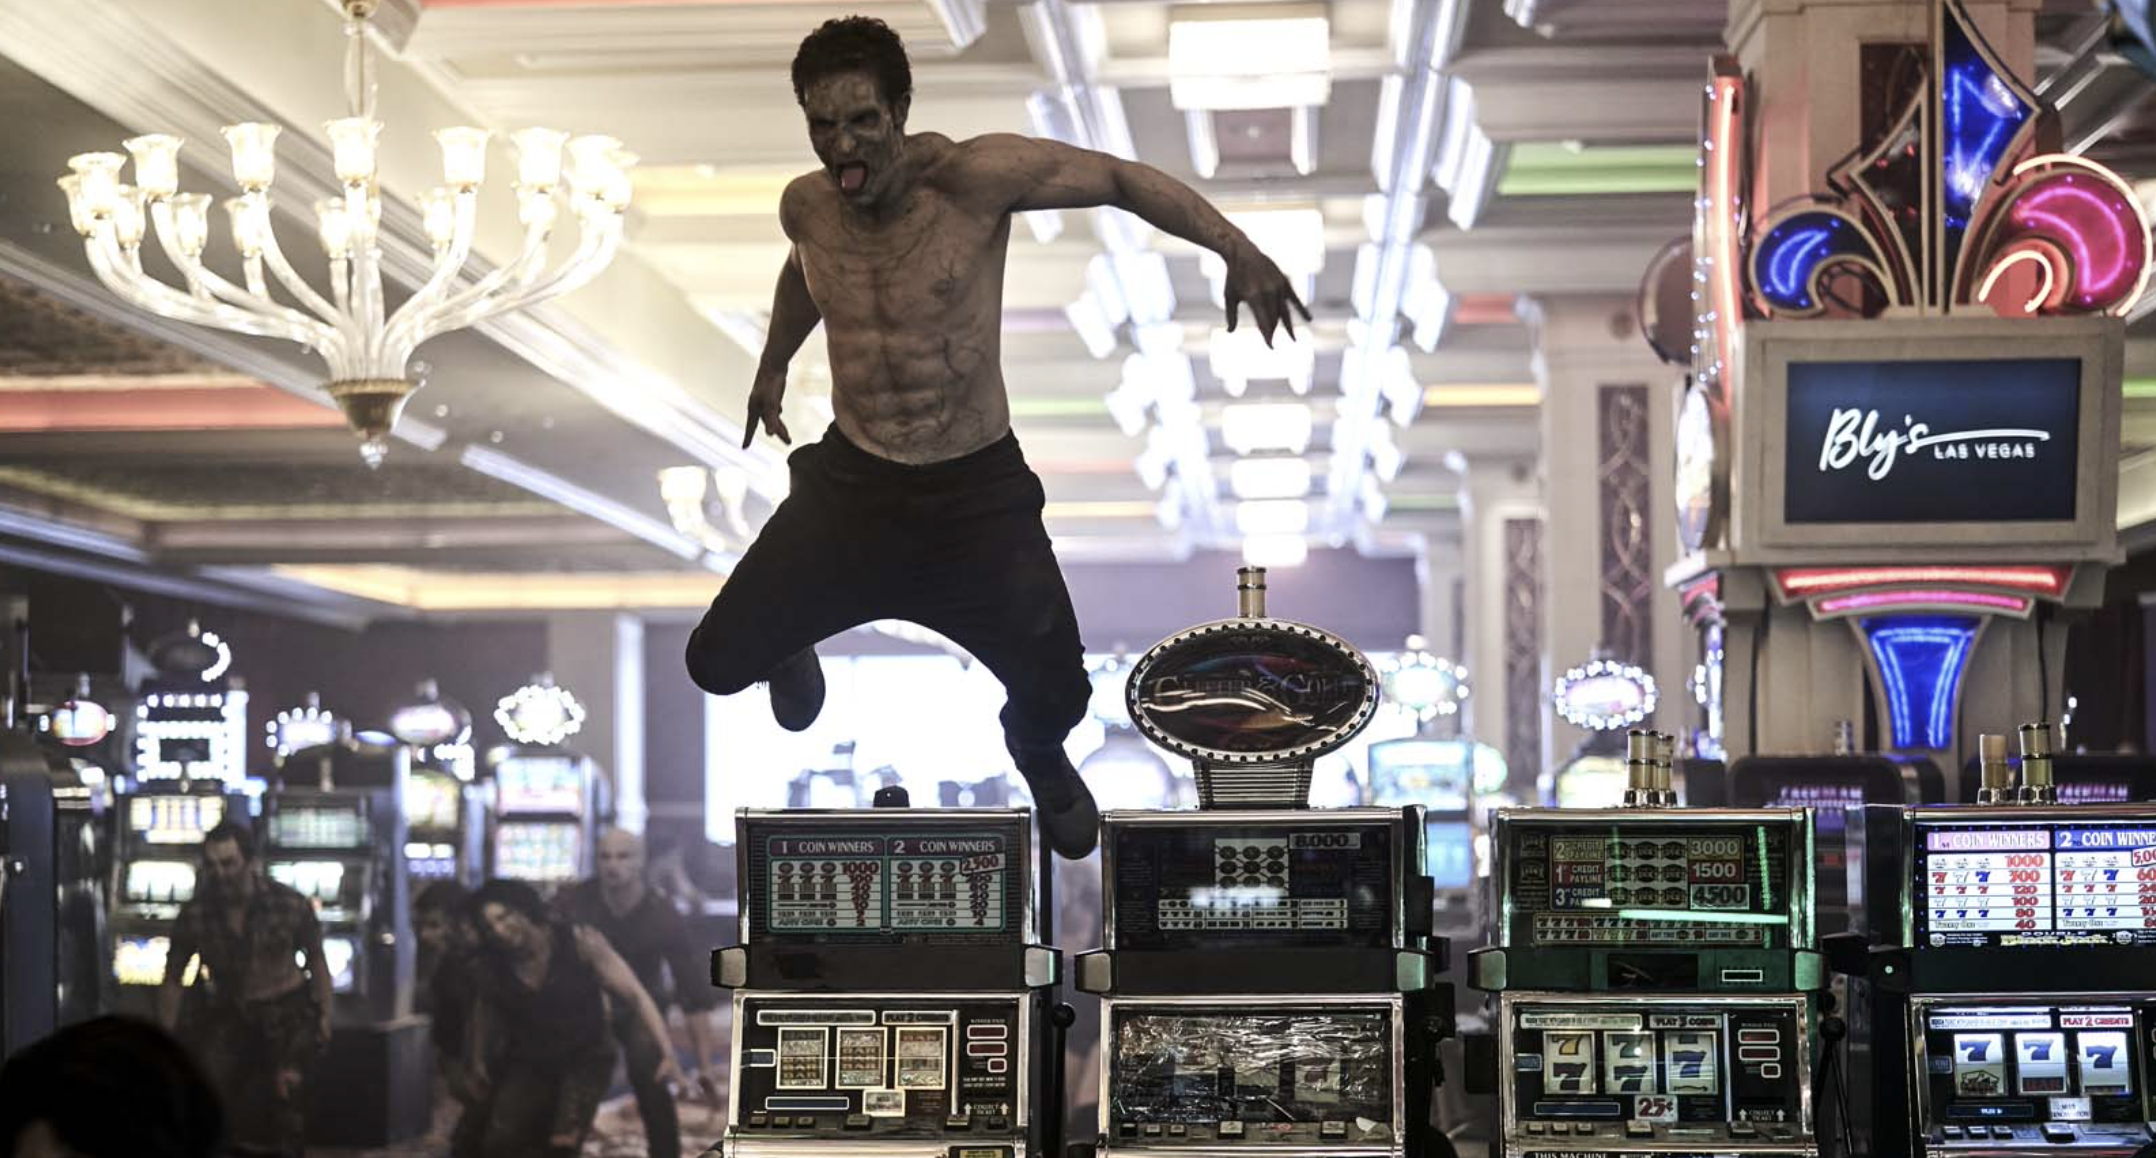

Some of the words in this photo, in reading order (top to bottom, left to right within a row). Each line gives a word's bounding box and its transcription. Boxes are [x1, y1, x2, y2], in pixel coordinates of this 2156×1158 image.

[1934, 443, 1968, 459] LAS
[1974, 443, 2035, 459] VEGAS
[1952, 833, 1984, 847] COIN
[1987, 832, 2045, 847] WINNERS
[2082, 832, 2113, 846] COIN
[799, 841, 826, 853] COIN
[828, 841, 875, 853] WINNERS
[894, 840, 906, 854] 2
[920, 841, 947, 853] COIN
[948, 841, 996, 853] WINNERS
[1691, 840, 1738, 855] 3000
[2005, 854, 2045, 868] 1000
[1571, 865, 1600, 873] CREDIT
[1692, 862, 1737, 878] 1500
[1571, 888, 1600, 896] CREDIT
[1694, 885, 1747, 904] 4500
[2062, 1017, 2084, 1025] PLAY
[2085, 1016, 2093, 1026] 2
